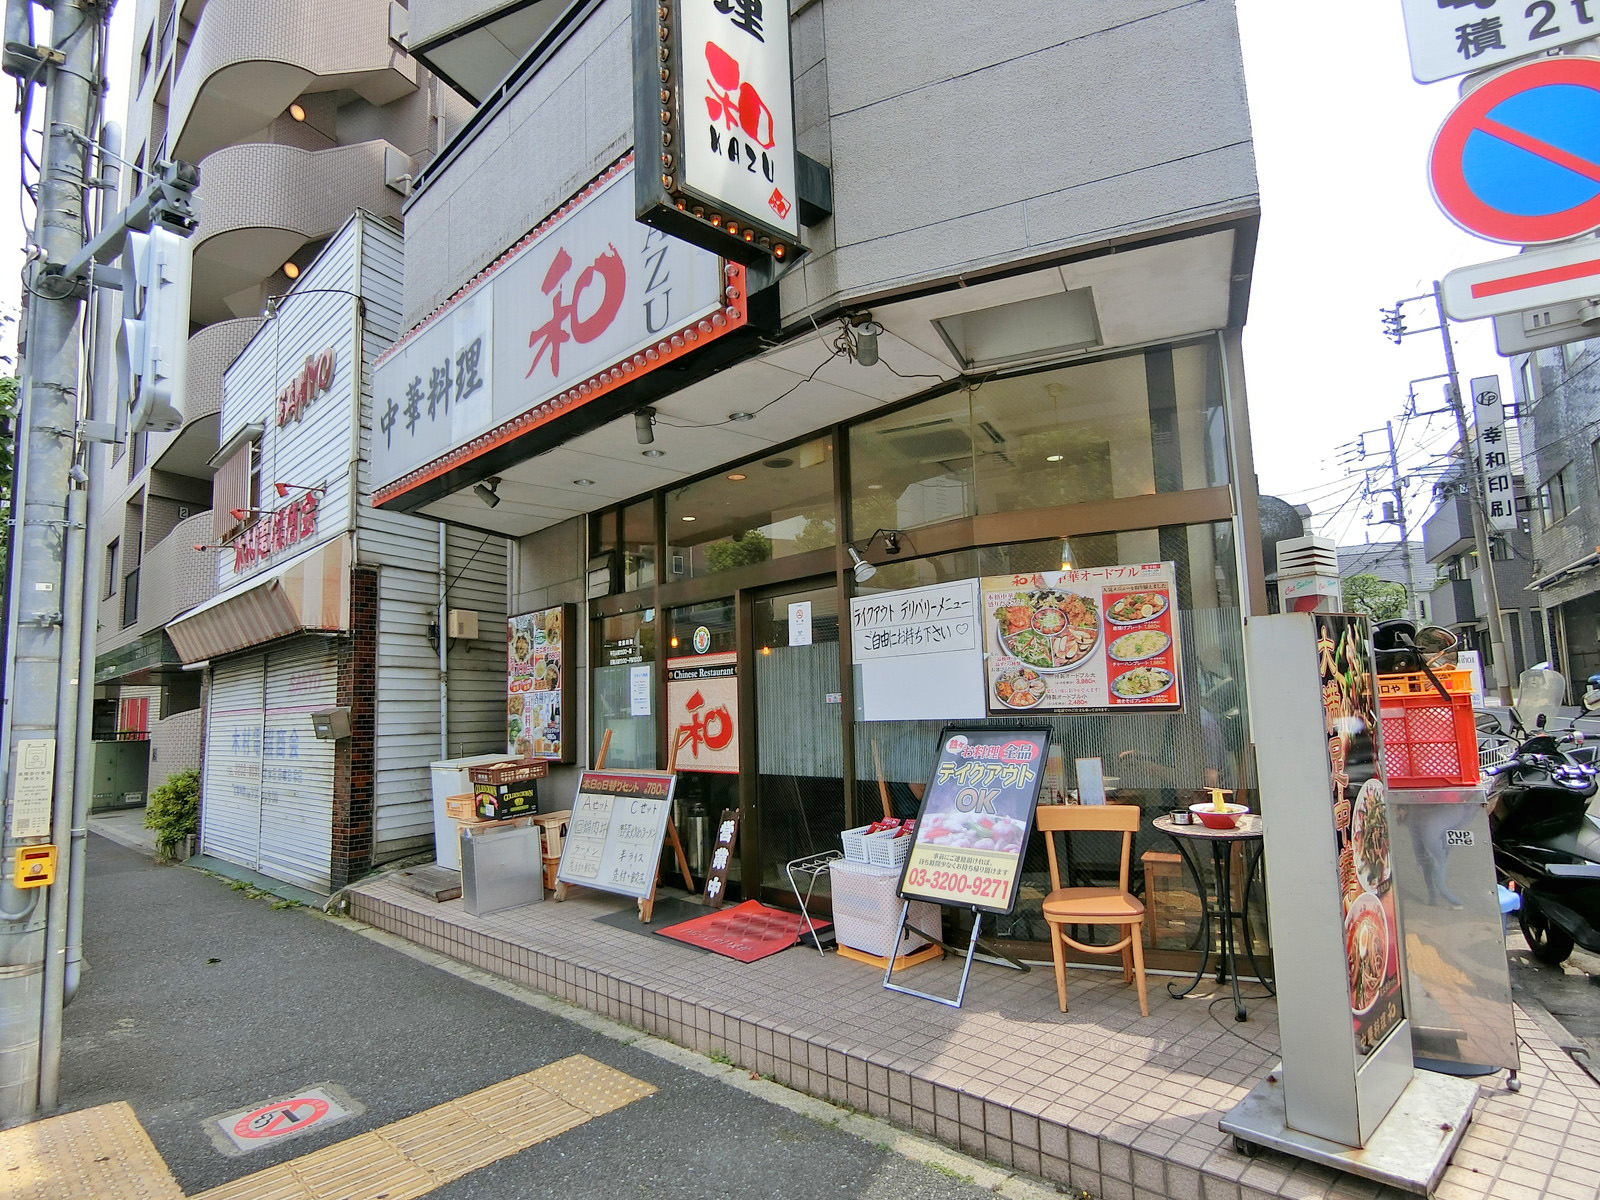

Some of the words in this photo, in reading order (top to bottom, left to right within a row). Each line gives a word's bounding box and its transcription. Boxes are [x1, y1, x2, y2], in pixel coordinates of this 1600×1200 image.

[709, 124, 774, 183] KAZU
[524, 242, 627, 379] 和
[276, 347, 336, 429] SANYO
[380, 337, 485, 451] 中華料理
[1482, 427, 1513, 518] 幸和印刷
[854, 604, 894, 627] テイクアウト
[901, 597, 971, 620] デリバリーメニュー
[864, 625, 952, 650] ご自由にお持ち下さい
[674, 670, 698, 679] Chinese
[699, 667, 734, 677] Restaurant
[1378, 684, 1401, 694] 口や
[677, 689, 734, 759] 和
[582, 779, 640, 793] 本日の日替りセット
[938, 761, 1036, 789] テイクアウト
[956, 788, 1001, 815] OK
[573, 845, 599, 857] ラーメン
[707, 820, 735, 899] 営業中
[908, 867, 1010, 901] 03-3200-9271
